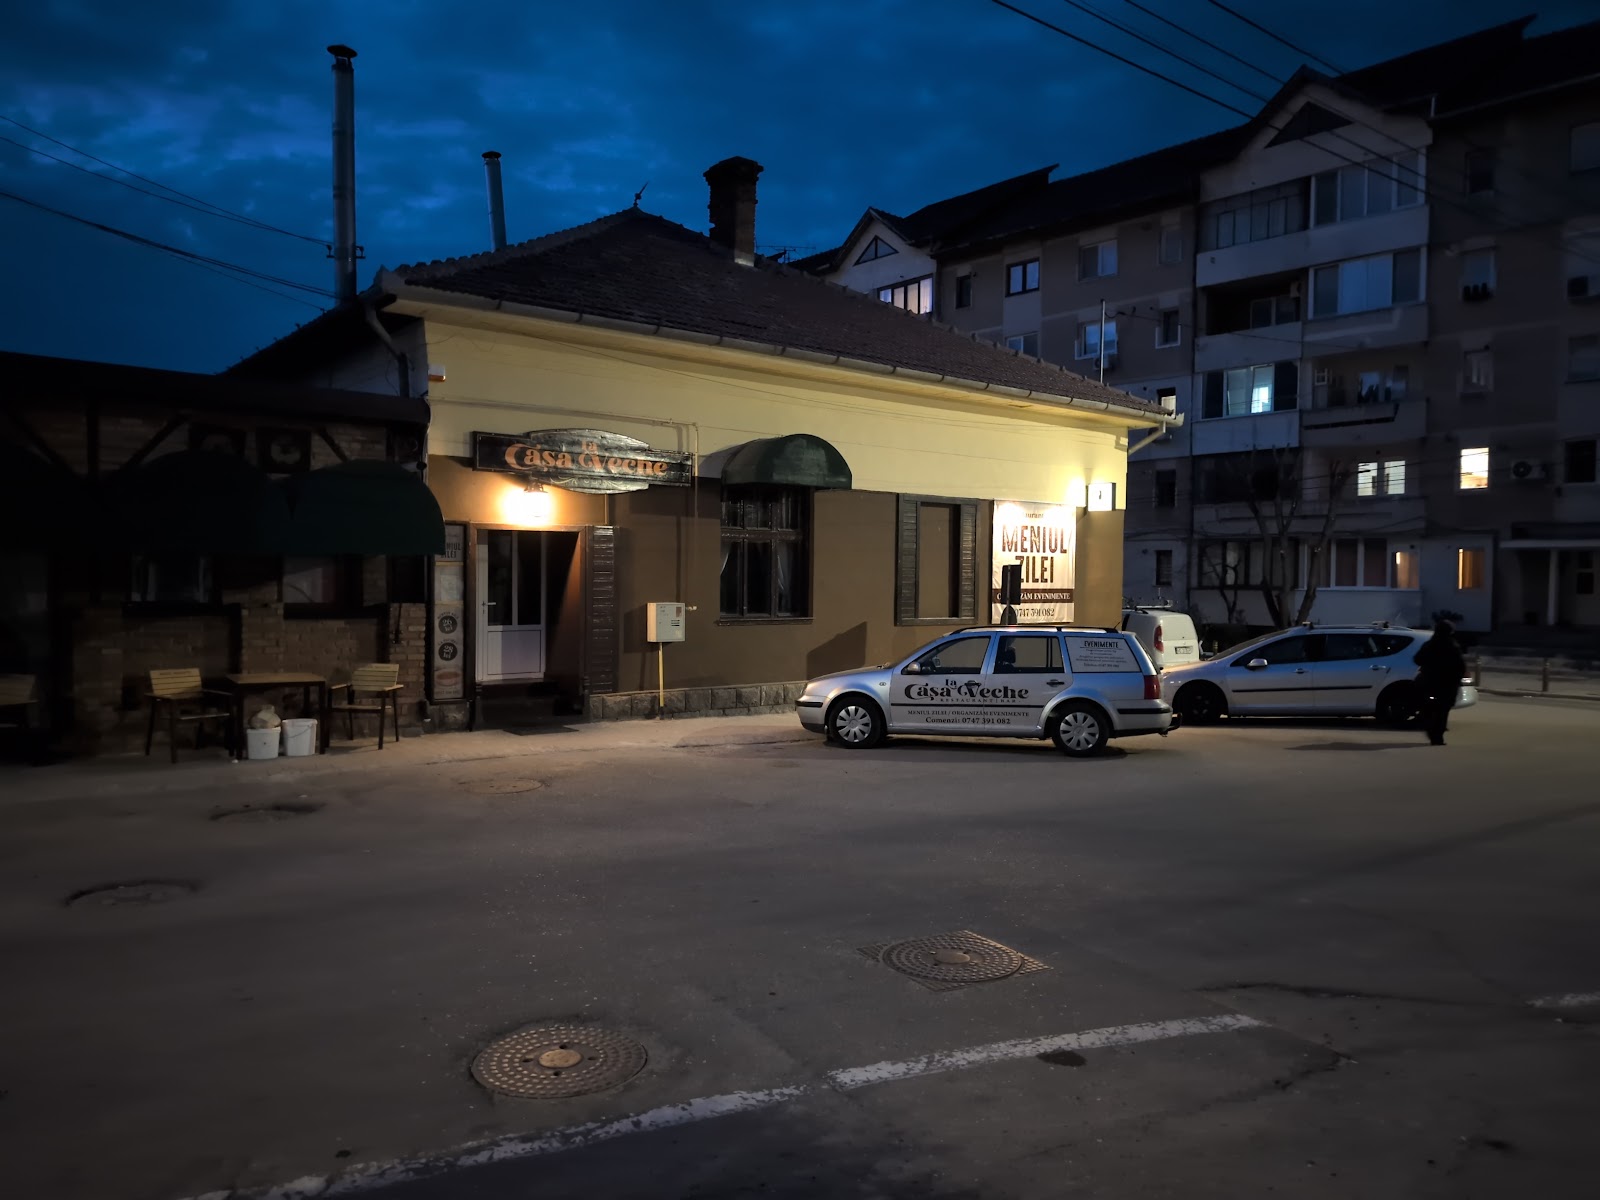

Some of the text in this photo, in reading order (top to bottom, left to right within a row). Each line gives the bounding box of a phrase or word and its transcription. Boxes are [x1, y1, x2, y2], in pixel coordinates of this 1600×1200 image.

[1002, 524, 1067, 554] MENIUL
[1034, 592, 1071, 600] EVENIMENTE
[1042, 608, 1055, 616] 082
[1084, 640, 1119, 648] EVENIMENTE
[957, 683, 1029, 699] Veche
